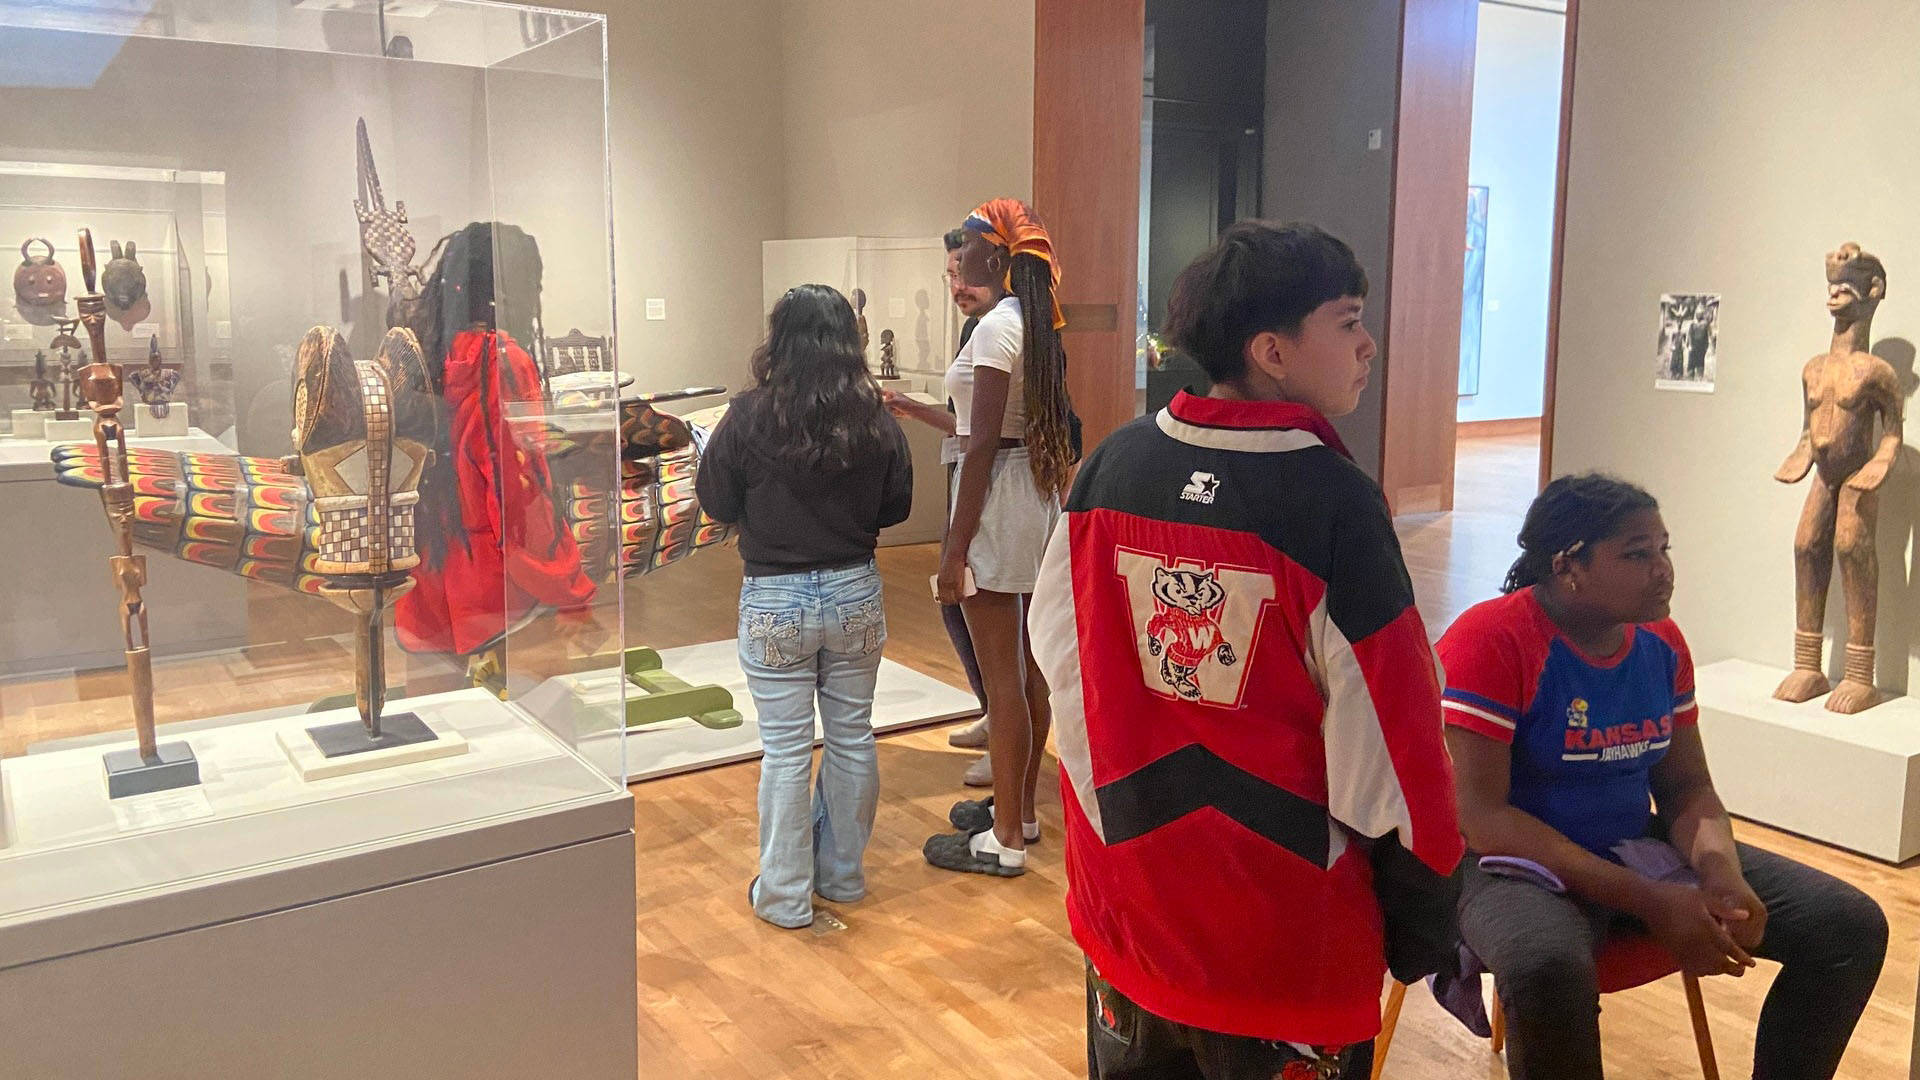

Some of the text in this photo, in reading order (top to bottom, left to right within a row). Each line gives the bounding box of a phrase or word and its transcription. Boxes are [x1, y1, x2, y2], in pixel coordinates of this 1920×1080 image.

[1180, 492, 1215, 504] STARTER
[1114, 544, 1278, 710] W
[1187, 625, 1216, 650] W
[1564, 714, 1672, 750] KANSAS
